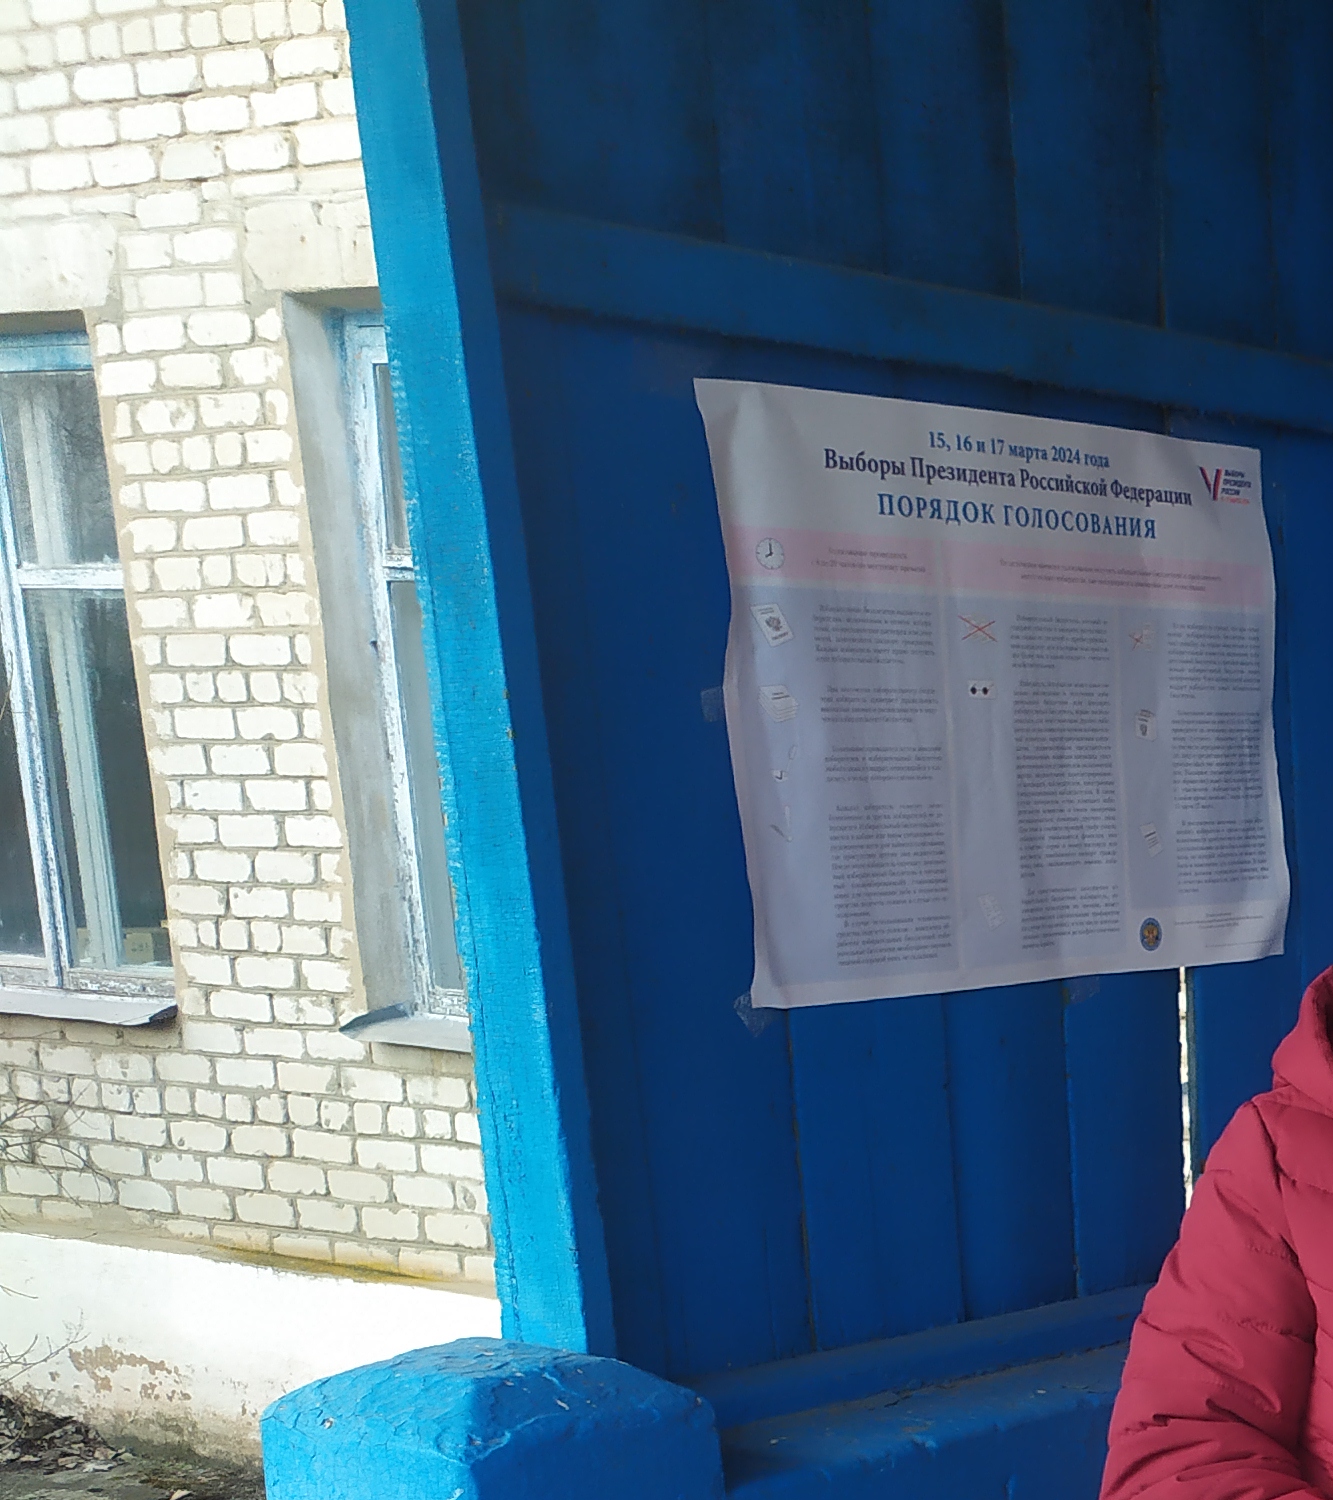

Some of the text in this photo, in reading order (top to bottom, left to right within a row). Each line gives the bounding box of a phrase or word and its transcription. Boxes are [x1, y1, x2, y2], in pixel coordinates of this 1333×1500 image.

[929, 431, 1110, 470] 15, 16 и 17 марта 2024 года
[824, 448, 1192, 507] Выборы Президента Российской Федерации
[877, 493, 1157, 539] ПОРЯДОК ГОЛОСОВАНИЯ
